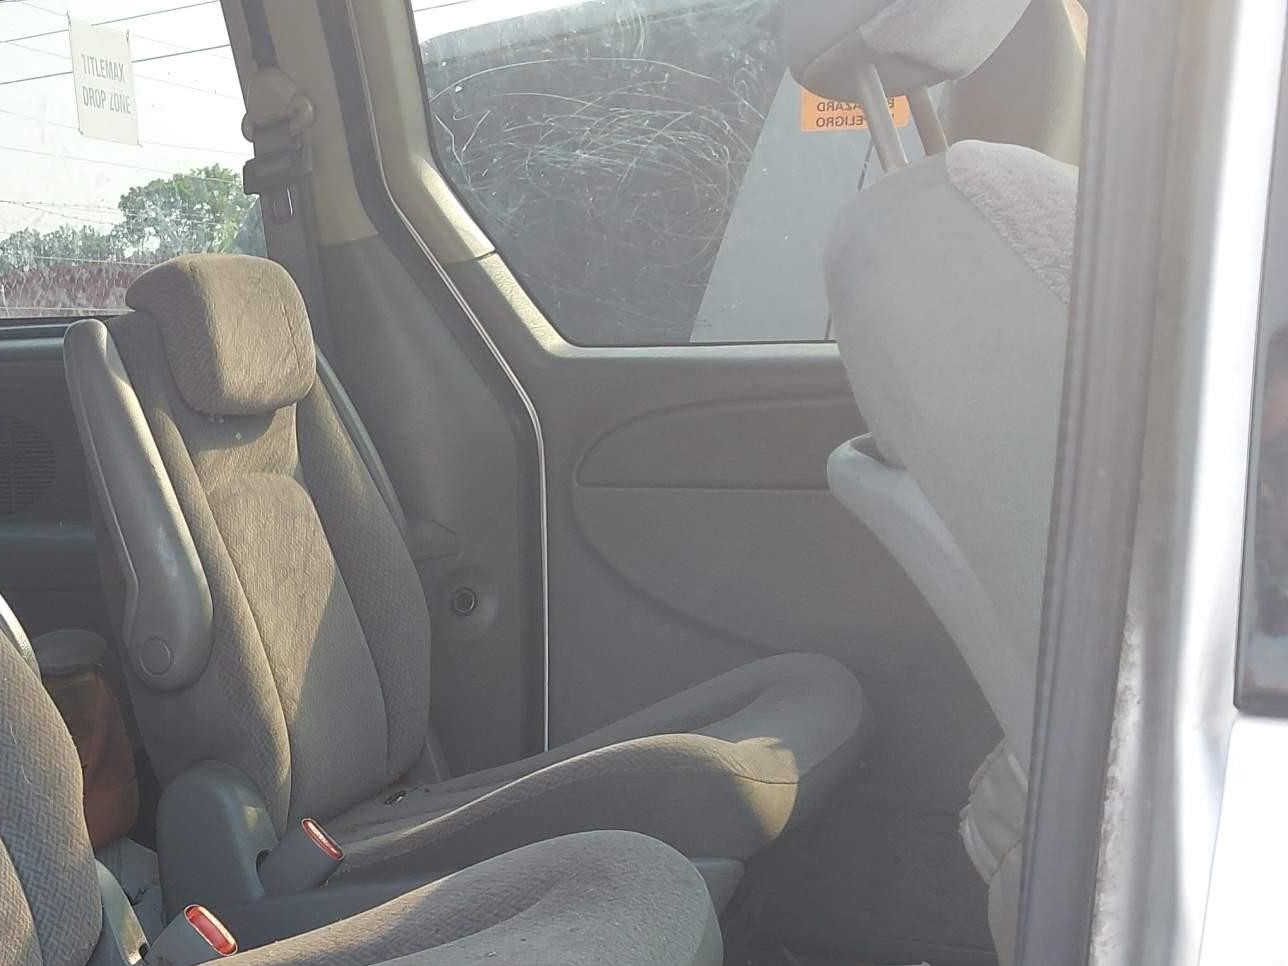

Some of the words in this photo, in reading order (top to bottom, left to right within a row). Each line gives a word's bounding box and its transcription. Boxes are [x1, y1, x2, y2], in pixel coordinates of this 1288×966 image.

[81, 54, 125, 83] TITLEMAX
[82, 86, 106, 109] DROP
[110, 93, 131, 114] ZONE
